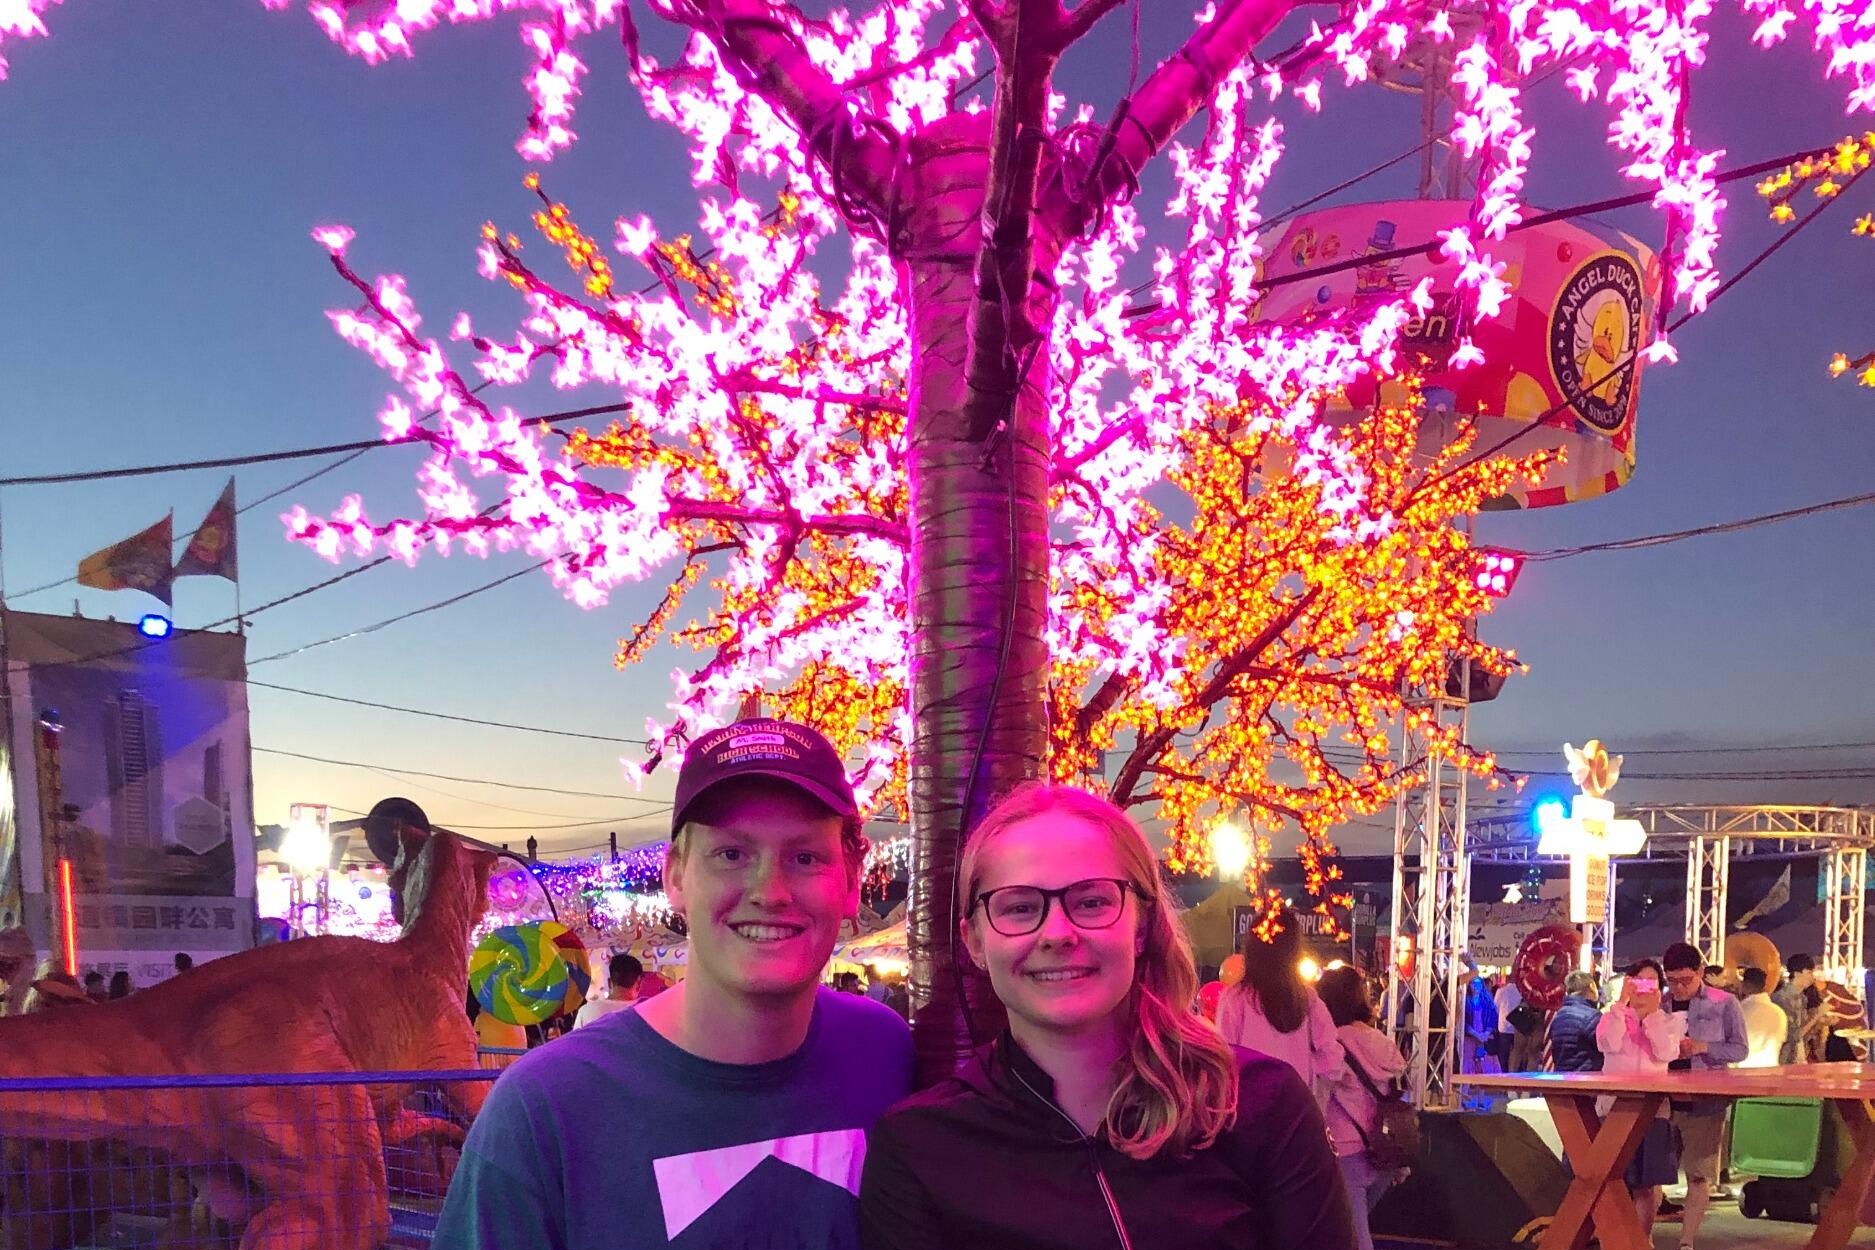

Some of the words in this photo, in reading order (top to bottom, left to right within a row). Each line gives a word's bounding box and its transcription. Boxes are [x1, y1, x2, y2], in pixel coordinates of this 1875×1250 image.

[1562, 267, 1605, 320] ANGEL
[1607, 264, 1636, 298] DUCK
[1588, 404, 1616, 424] SINCE
[748, 743, 800, 760] SCHOOL
[1470, 942, 1512, 961] Newjobs
